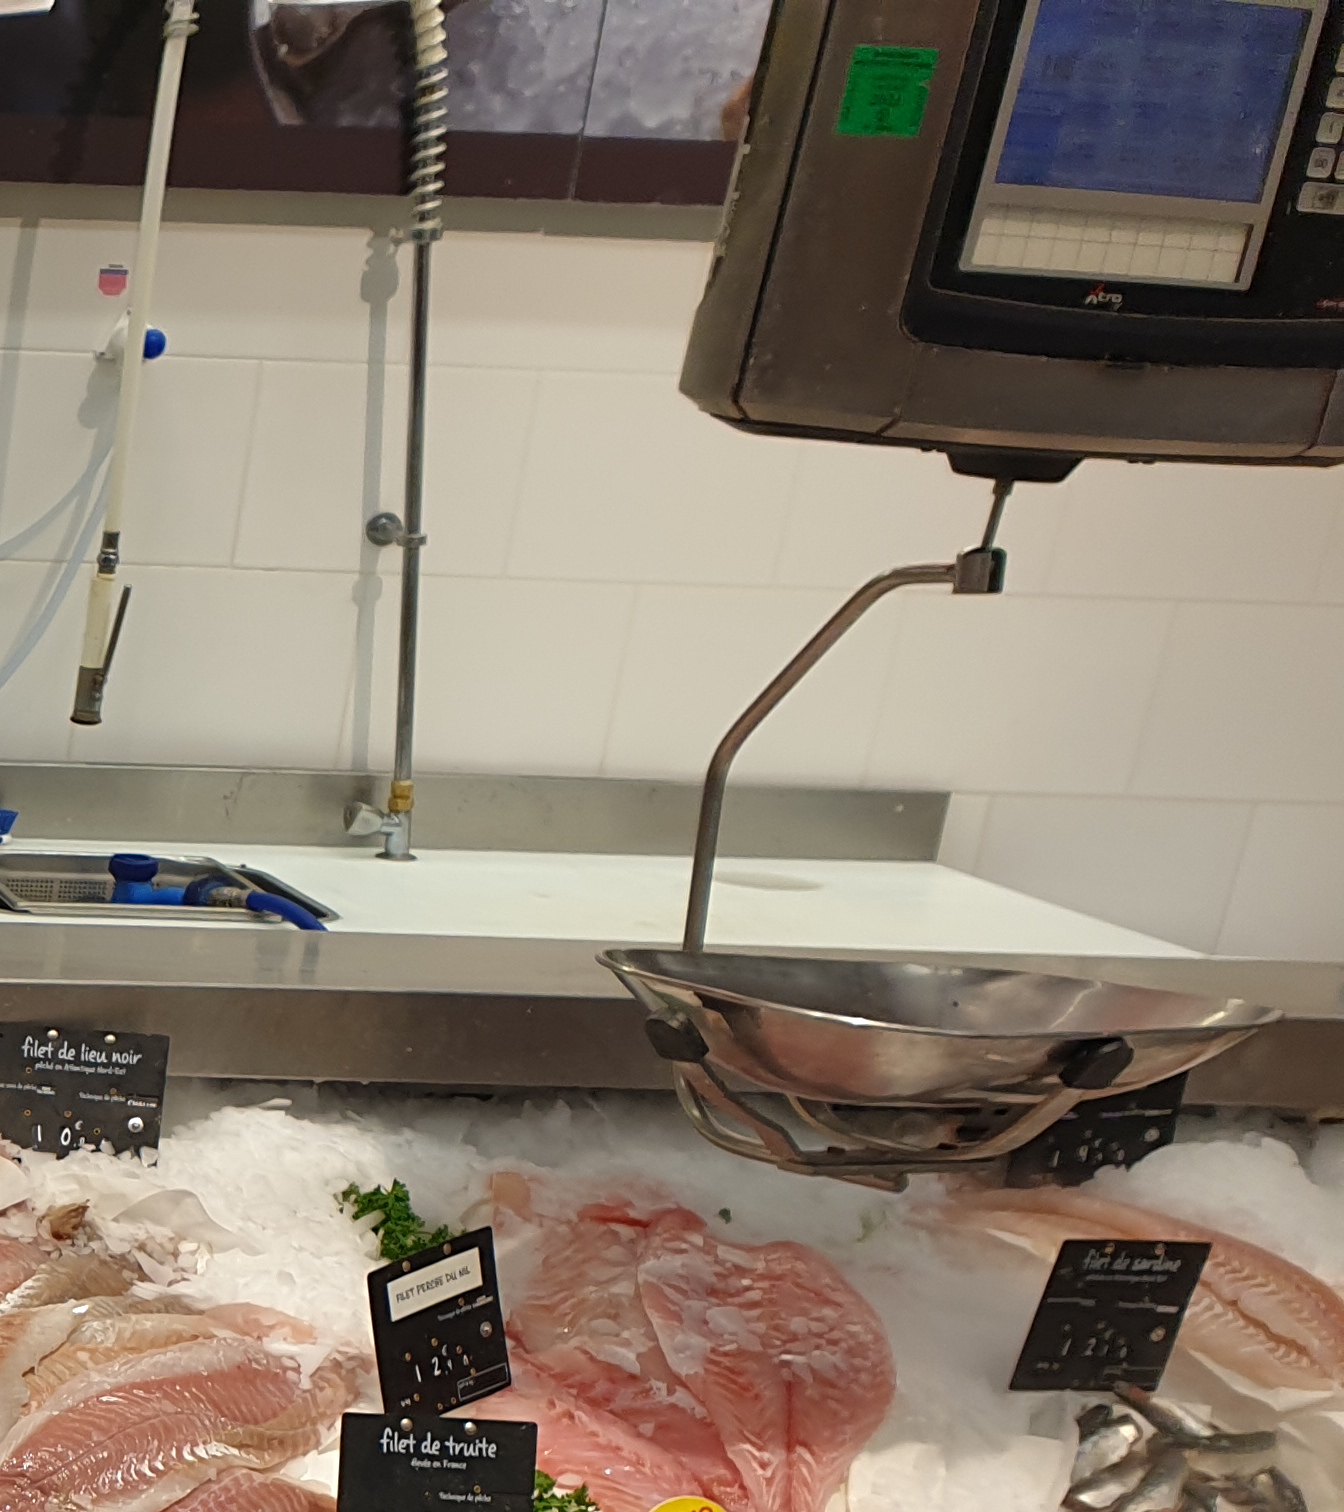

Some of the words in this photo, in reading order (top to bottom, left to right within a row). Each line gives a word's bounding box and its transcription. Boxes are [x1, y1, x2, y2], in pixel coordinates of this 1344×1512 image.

[21, 1035, 53, 1059] filet
[58, 1041, 77, 1060] de
[80, 1043, 108, 1063] lieu
[112, 1048, 143, 1065] noir
[395, 1287, 416, 1303] FILET
[379, 1426, 417, 1454] filet
[421, 1431, 441, 1456] de
[445, 1435, 498, 1459] truite
